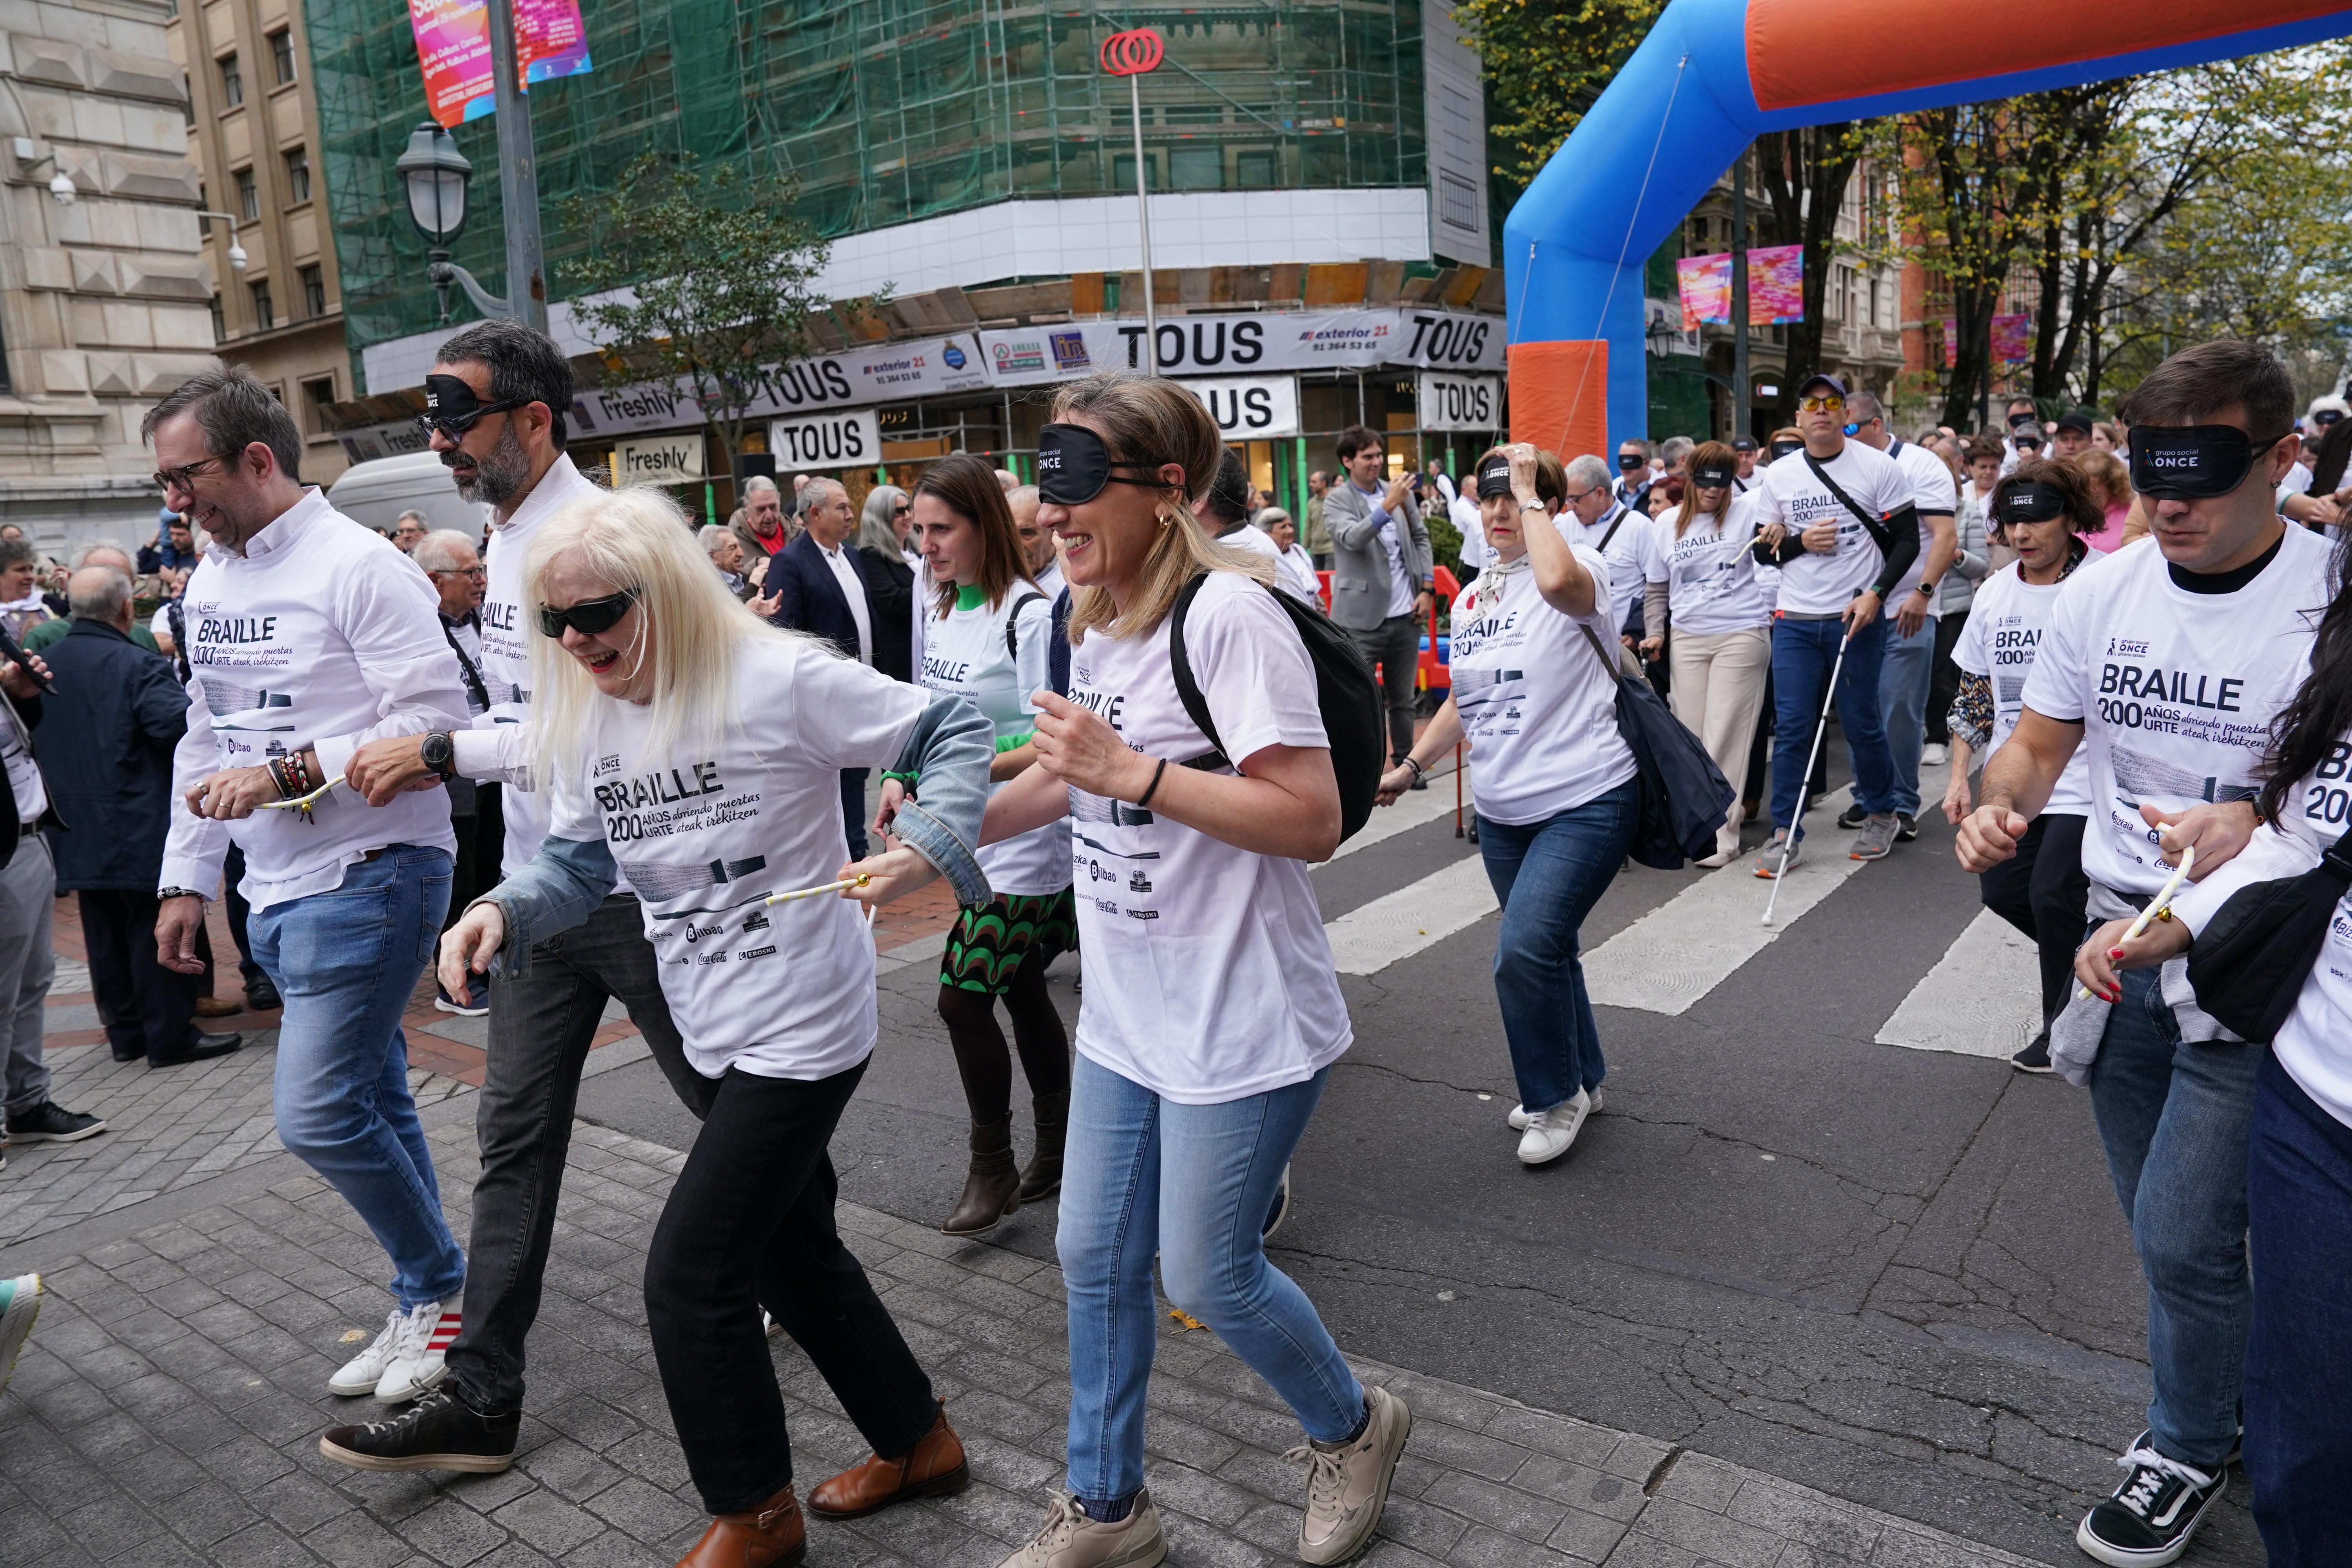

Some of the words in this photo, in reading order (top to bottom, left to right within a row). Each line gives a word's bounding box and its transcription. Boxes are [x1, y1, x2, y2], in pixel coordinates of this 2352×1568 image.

[1118, 321, 1263, 368] TOUS
[1316, 327, 1371, 340] exterior
[1373, 325, 1389, 337] 21
[1328, 341, 1346, 350] 364
[1348, 341, 1362, 350] 53
[1408, 315, 1489, 363] TOUS
[760, 359, 851, 407] TOUS
[873, 359, 911, 373] exterior
[912, 355, 927, 368] 21
[887, 374, 900, 383] 364
[599, 389, 676, 421] Freshly
[1433, 382, 1489, 422] TOUS
[380, 427, 430, 452] Fresh
[784, 419, 863, 463] TOUS
[626, 445, 687, 472] Freshly
[1039, 457, 1061, 470] ONCE
[2155, 457, 2198, 468] ONCE
[1489, 470, 1509, 478] ONCE
[1792, 495, 1840, 511] BRAILL
[1793, 510, 1813, 522] 200
[1674, 532, 1726, 552] BRAILLE
[1675, 550, 1692, 562] 200
[198, 617, 277, 644] BRAILLE
[192, 645, 217, 665] 200
[214, 646, 237, 655] AÑOS
[261, 646, 293, 660] puertas
[1994, 650, 2024, 665] 200
[2119, 644, 2148, 653] ONCE
[214, 656, 230, 666] URTE
[233, 655, 252, 667] ateak
[253, 654, 290, 667] irekitzen
[926, 680, 939, 691] AÑOS
[2099, 663, 2244, 713] BRAILLE
[2098, 697, 2142, 729] 200
[2144, 704, 2181, 721] AÑOS
[2181, 711, 2221, 729] abriendo
[2143, 719, 2179, 734] URTE
[2182, 727, 2209, 742] ateak
[2212, 729, 2268, 750] irekitzen
[229, 740, 251, 753] Bilbao
[601, 759, 620, 770] ONCE
[594, 761, 724, 812] BRAILLE
[2306, 785, 2352, 824] 20
[607, 814, 644, 842] 200
[642, 810, 671, 826] AÑOS
[673, 800, 713, 821] abriendo
[715, 792, 761, 817] puertas
[644, 823, 674, 838] URTE
[677, 815, 703, 834] ateak
[706, 807, 760, 828] irekitzen
[2113, 814, 2134, 831] Bizkaia
[1091, 862, 1116, 882] Bilbao
[1095, 897, 1118, 915] Coca-Cola
[687, 924, 724, 941] Bilbao
[698, 949, 728, 965] Coca-Cola
[748, 947, 775, 958] EROSKI
